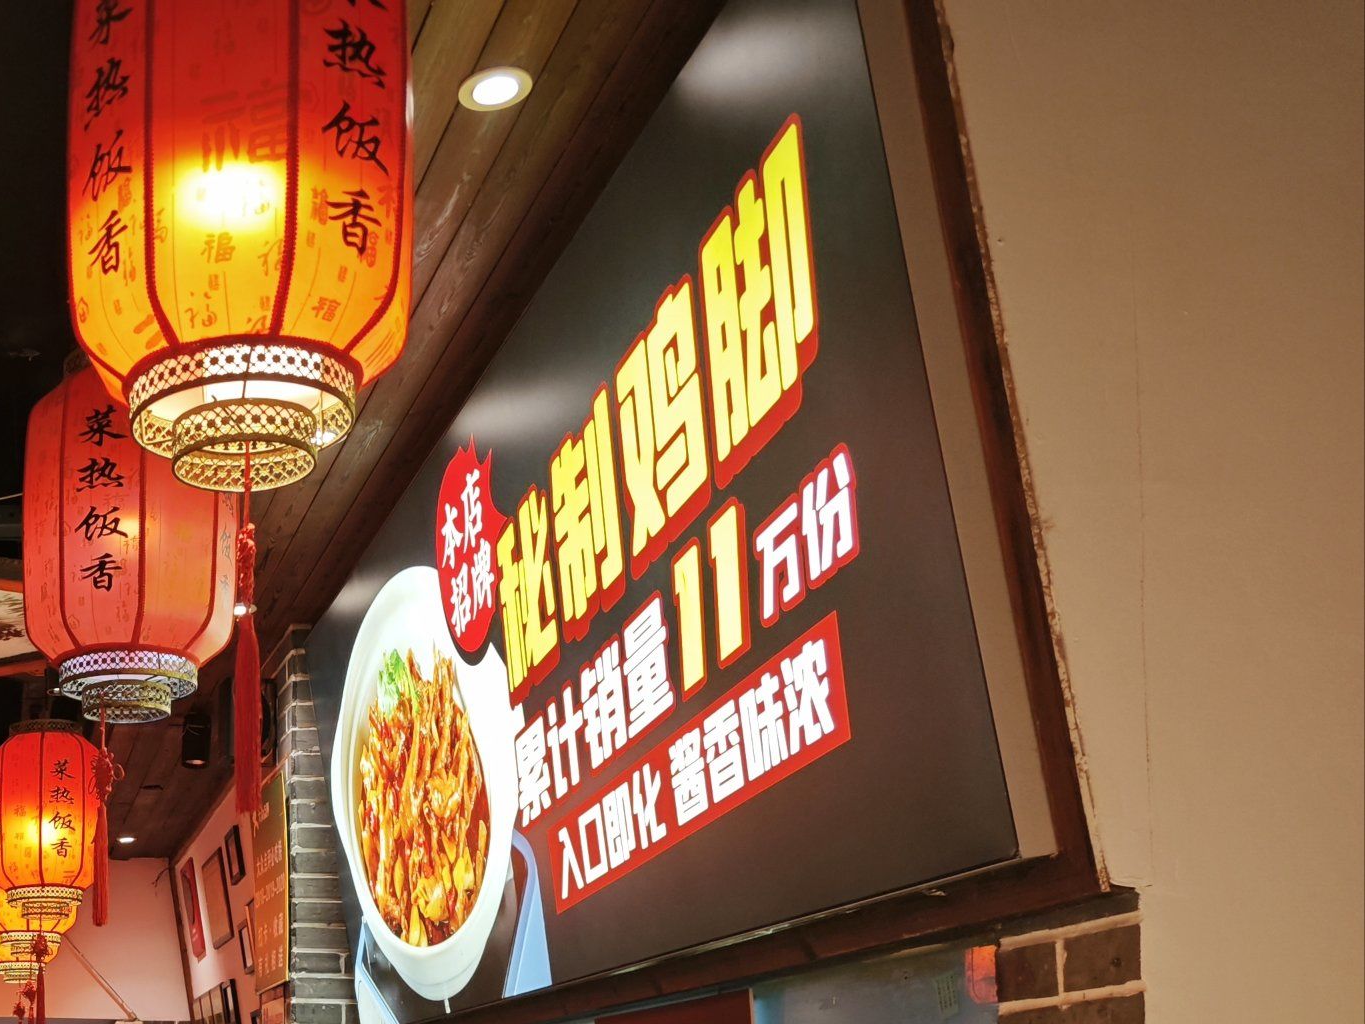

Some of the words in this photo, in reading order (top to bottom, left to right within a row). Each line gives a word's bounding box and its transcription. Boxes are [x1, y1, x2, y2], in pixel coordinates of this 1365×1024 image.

[322, 0, 389, 256] 热饭香
[74, 405, 128, 592] 菜热饭香
[498, 116, 818, 694] 秘制鸡脚
[438, 469, 483, 571] 本店
[449, 547, 494, 641] 招牌
[48, 760, 76, 858] 菜热饭香
[560, 760, 669, 902] 入口即化
[669, 637, 839, 826] 酱香味浓
